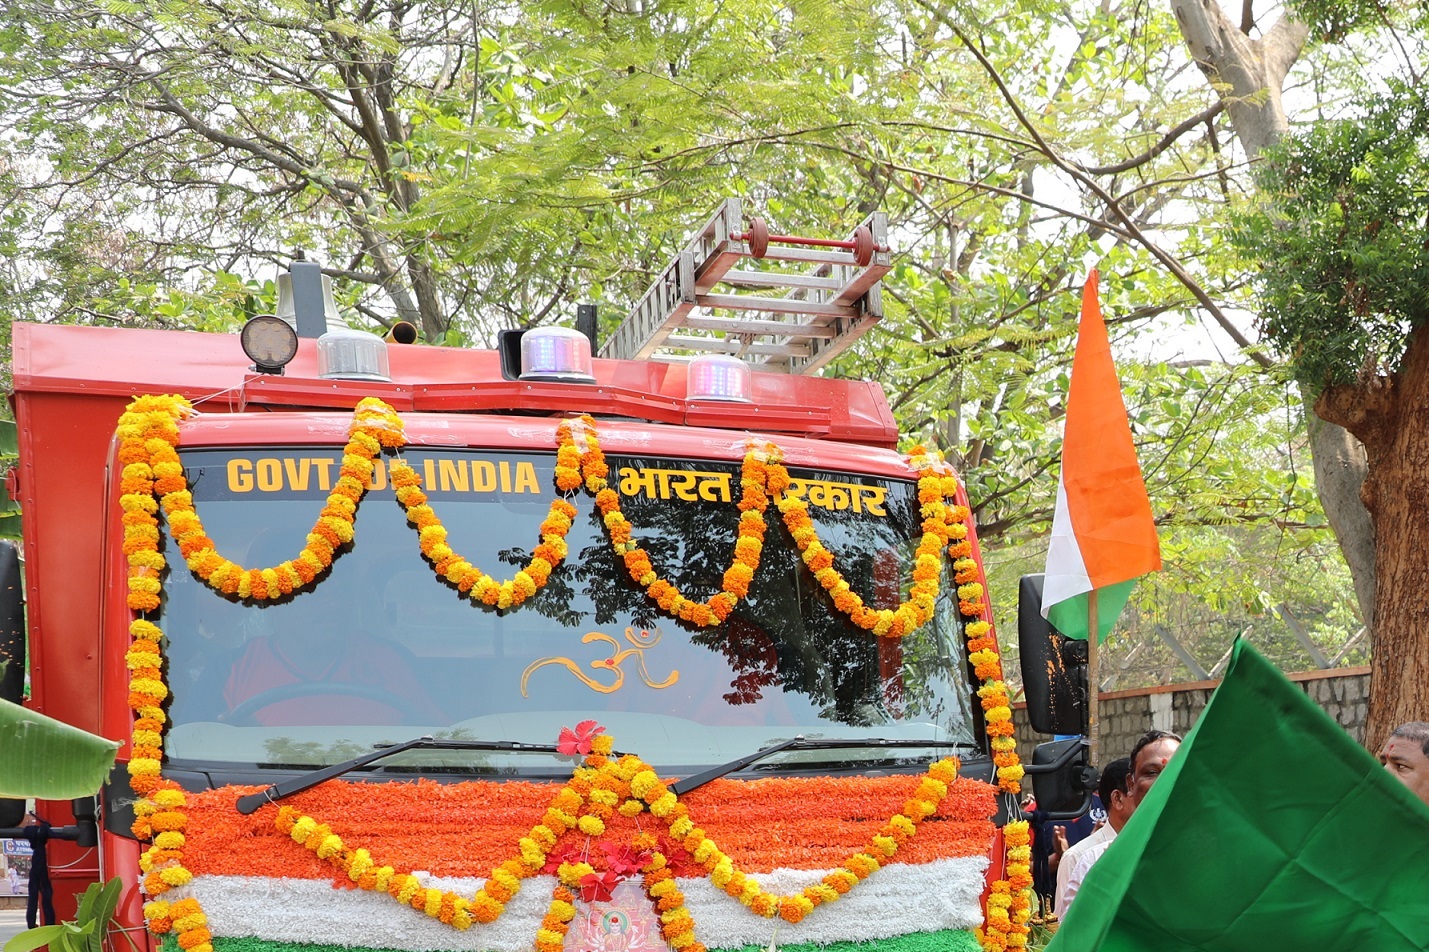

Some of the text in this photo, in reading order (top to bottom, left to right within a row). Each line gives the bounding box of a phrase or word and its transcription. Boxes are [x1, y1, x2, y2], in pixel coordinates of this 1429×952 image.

[425, 459, 540, 494] INDIA
[619, 467, 888, 517] भारत रकार
